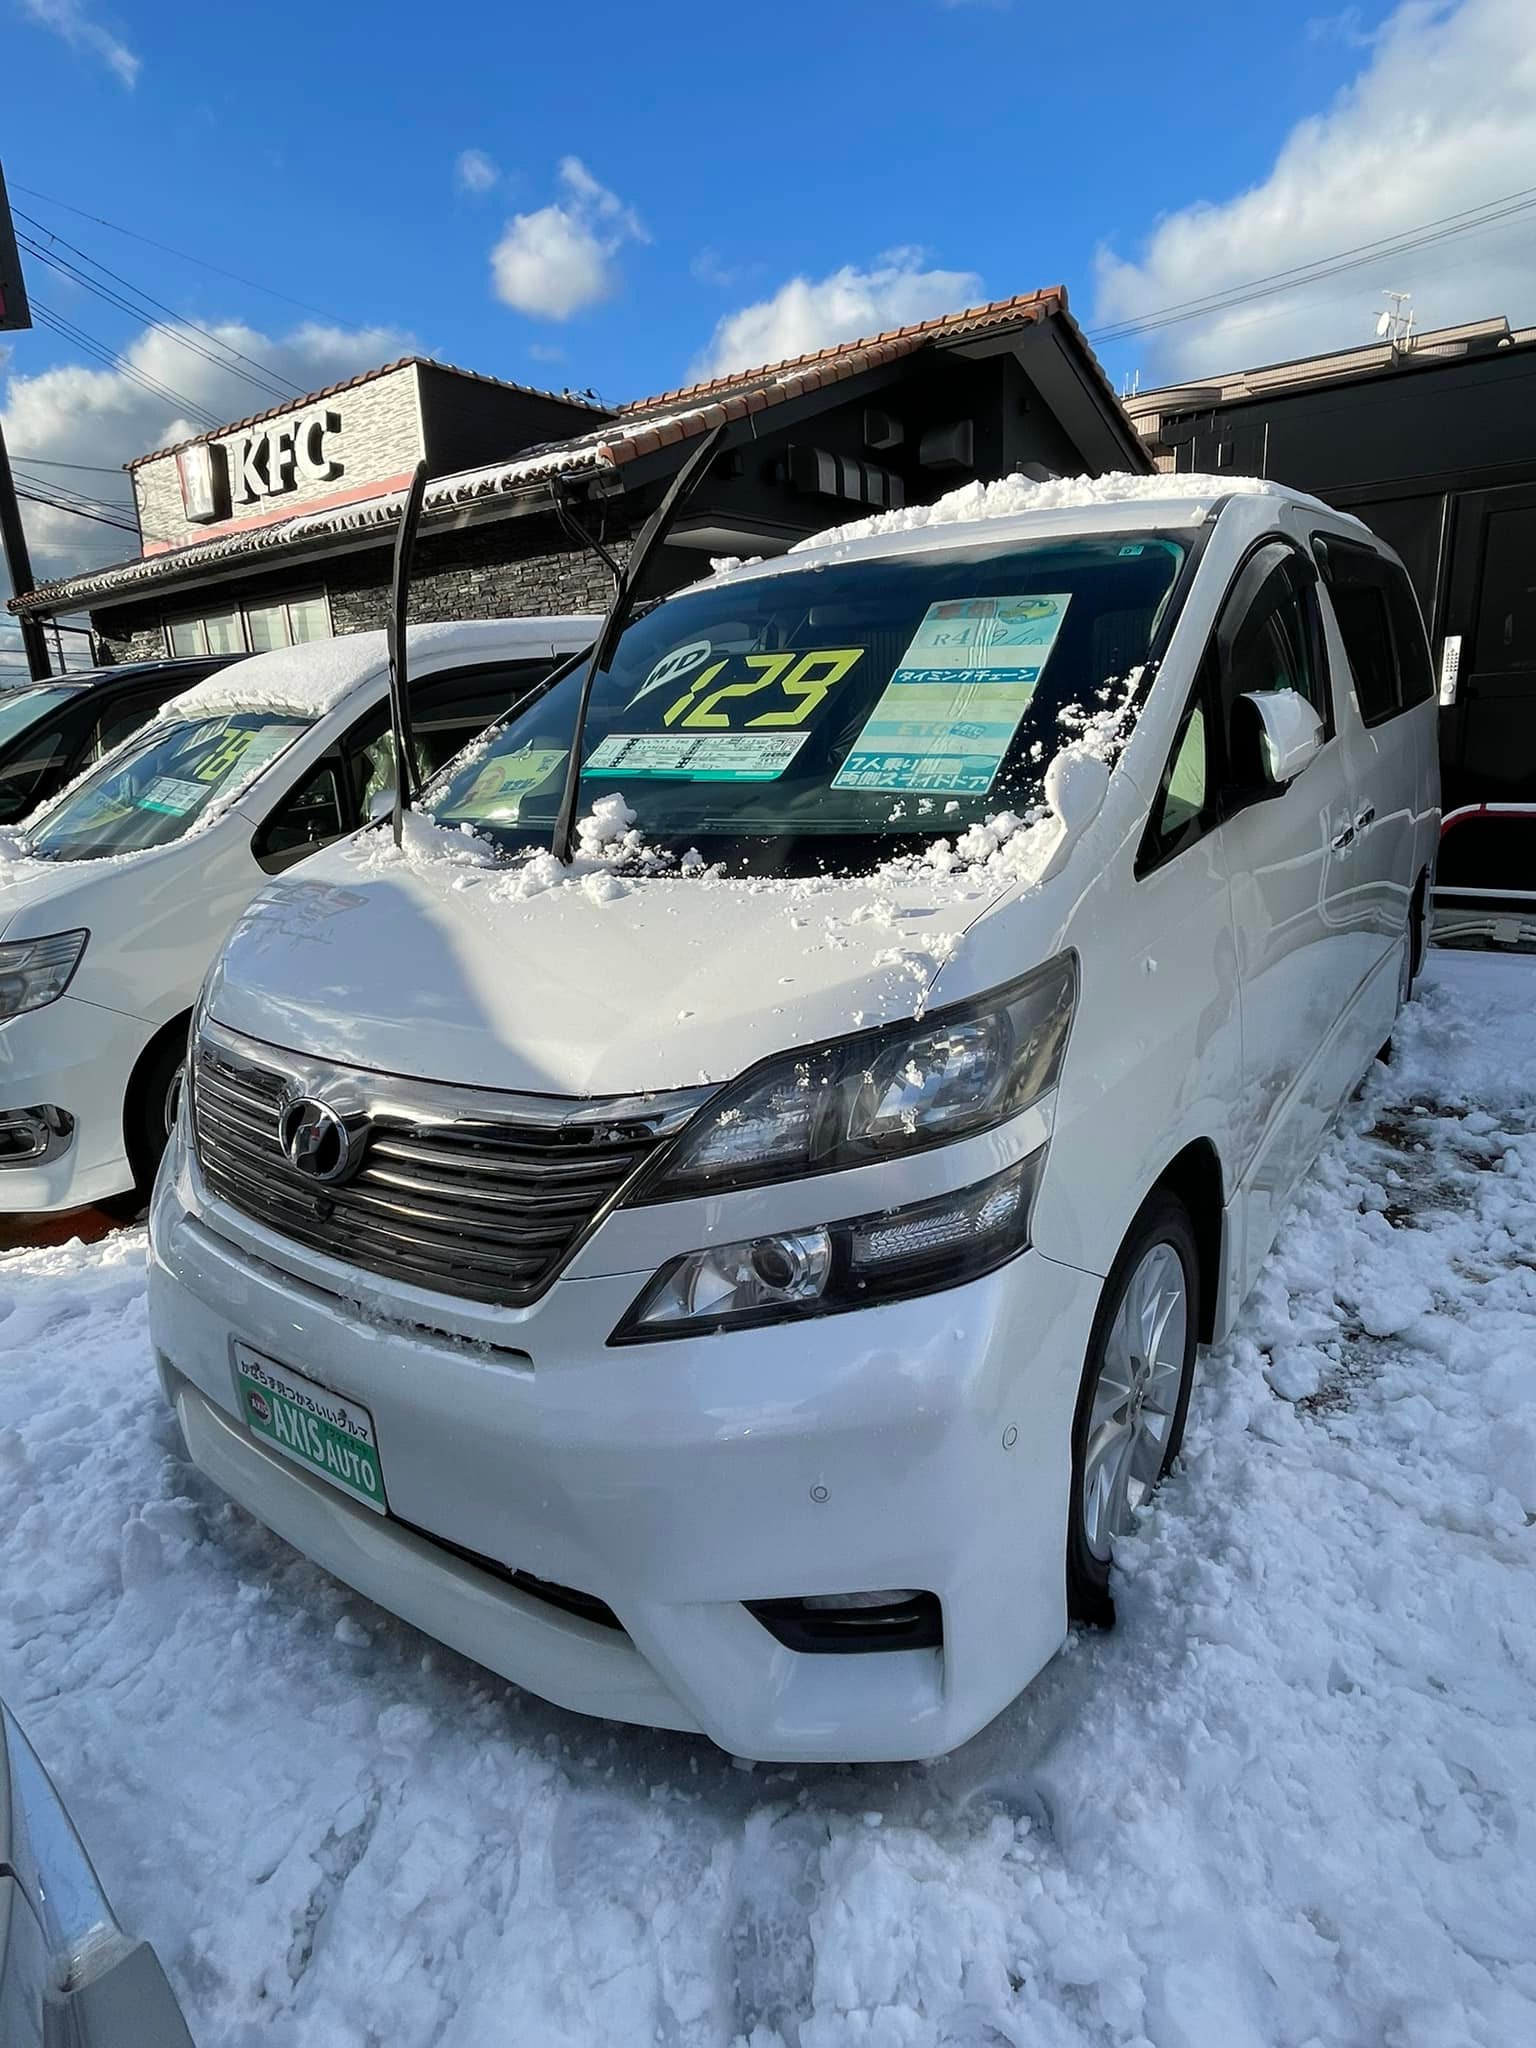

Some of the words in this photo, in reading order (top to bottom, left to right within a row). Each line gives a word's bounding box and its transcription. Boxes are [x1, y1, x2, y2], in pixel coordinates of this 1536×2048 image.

[228, 411, 340, 503] KFC
[663, 648, 865, 728] 129
[898, 668, 1035, 682] タイミングチェーン
[272, 1397, 325, 1462] AXIS
[326, 1439, 376, 1492] AUTO
